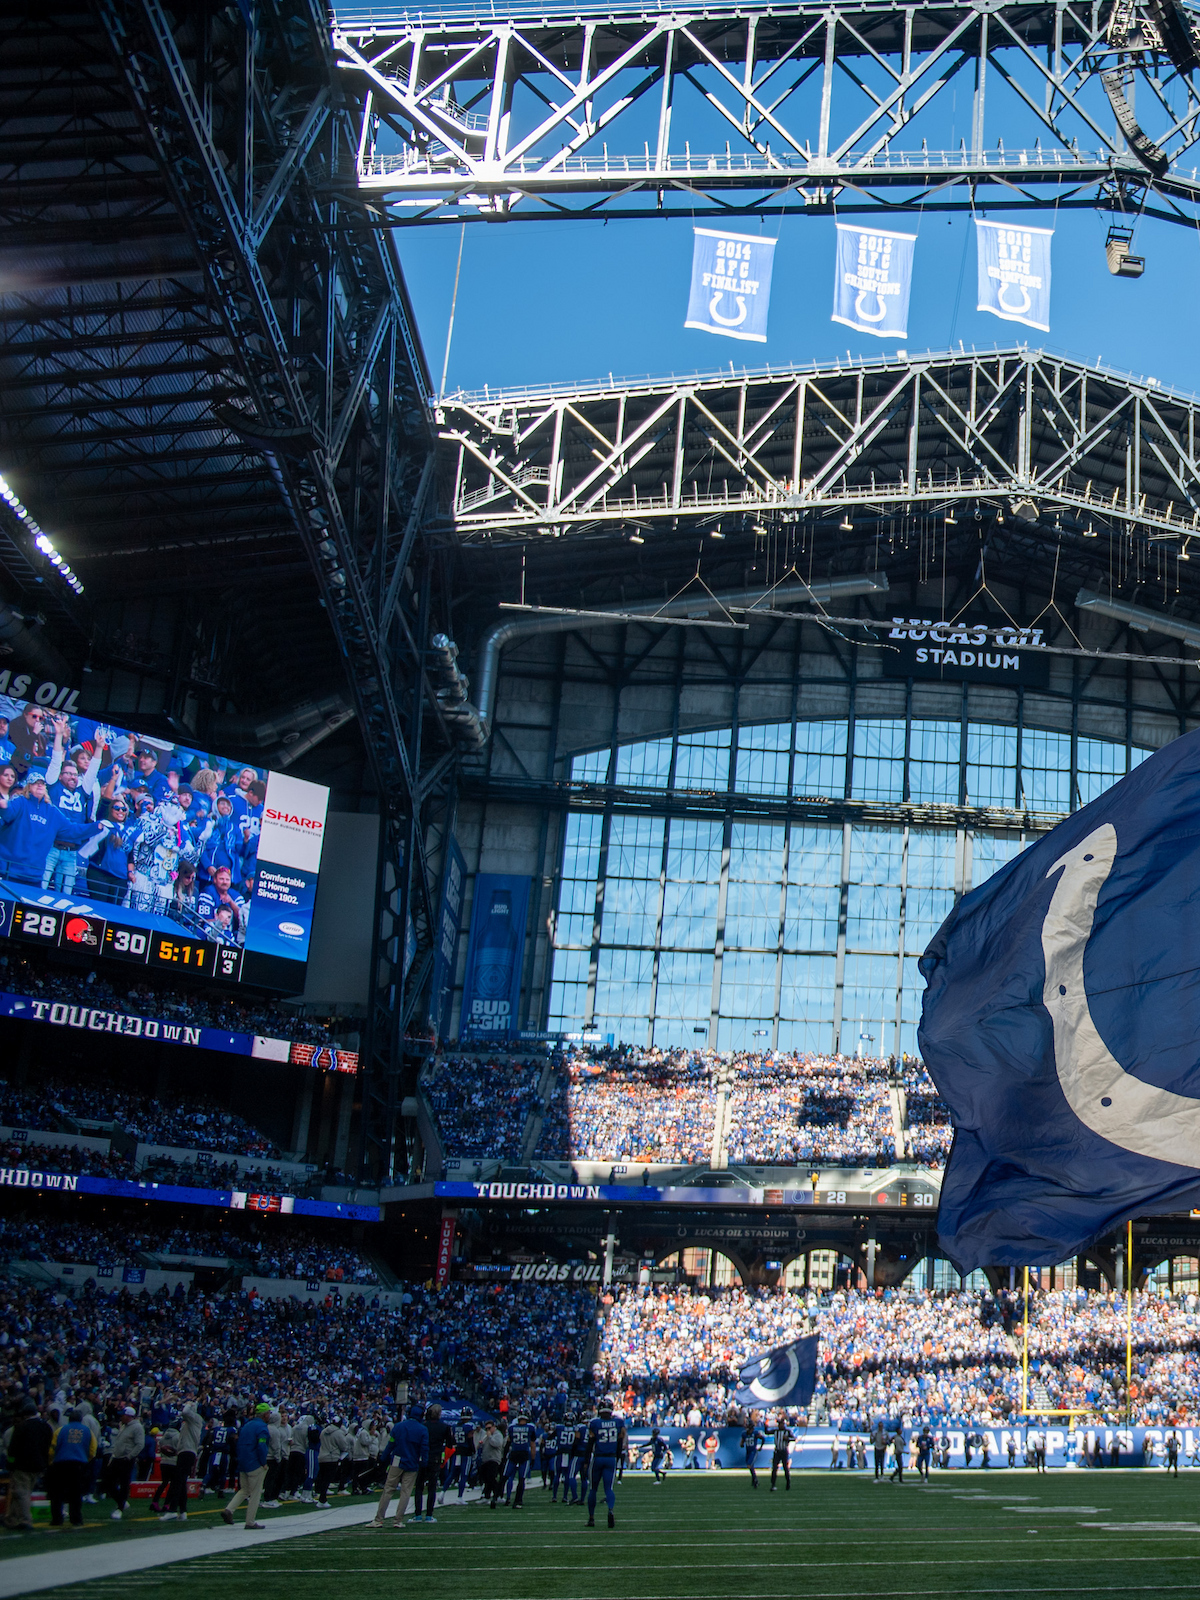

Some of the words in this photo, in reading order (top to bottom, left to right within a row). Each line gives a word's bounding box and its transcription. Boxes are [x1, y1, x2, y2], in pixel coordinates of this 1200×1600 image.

[859, 234, 892, 254] 2013
[998, 229, 1031, 248] 2010
[716, 240, 751, 260] 2014
[857, 264, 889, 283] SOUTH
[702, 272, 759, 295] FINALIST
[844, 272, 901, 295] CHAMPIONS
[888, 616, 990, 646] LUCAS
[915, 647, 1020, 671] STADIUM
[34, 681, 81, 714] OIL
[265, 808, 323, 830] SHARP
[258, 880, 268, 889] at
[267, 881, 290, 894] Home
[260, 870, 306, 889] Comfortable
[257, 888, 279, 900] Since
[23, 912, 57, 937] 28
[114, 931, 146, 955] 30
[159, 940, 205, 967] 5:11
[222, 949, 239, 960] QTR
[222, 960, 234, 975] 3
[471, 1000, 511, 1016] BUD
[30, 1000, 202, 1047] TOUCHDOWN
[536, 1032, 557, 1040] LIGHT
[558, 1032, 582, 1041] PARTY
[477, 1181, 601, 1200] TOUCHDOWN
[826, 1191, 848, 1205] 28
[913, 1193, 934, 1207] 30
[556, 1226, 604, 1234] STADIUM
[694, 1228, 725, 1238] LUCAS
[726, 1228, 743, 1238] OIL
[744, 1229, 790, 1239] STADIUM
[440, 1220, 451, 1265] LUCAS
[1140, 1237, 1169, 1246] LUCAS
[1169, 1237, 1186, 1246] OIL
[511, 1263, 572, 1281] LUCAS
[572, 1264, 601, 1282] OIL
[214, 1430, 228, 1444] 51
[512, 1432, 529, 1445] 25
[560, 1431, 576, 1445] 50
